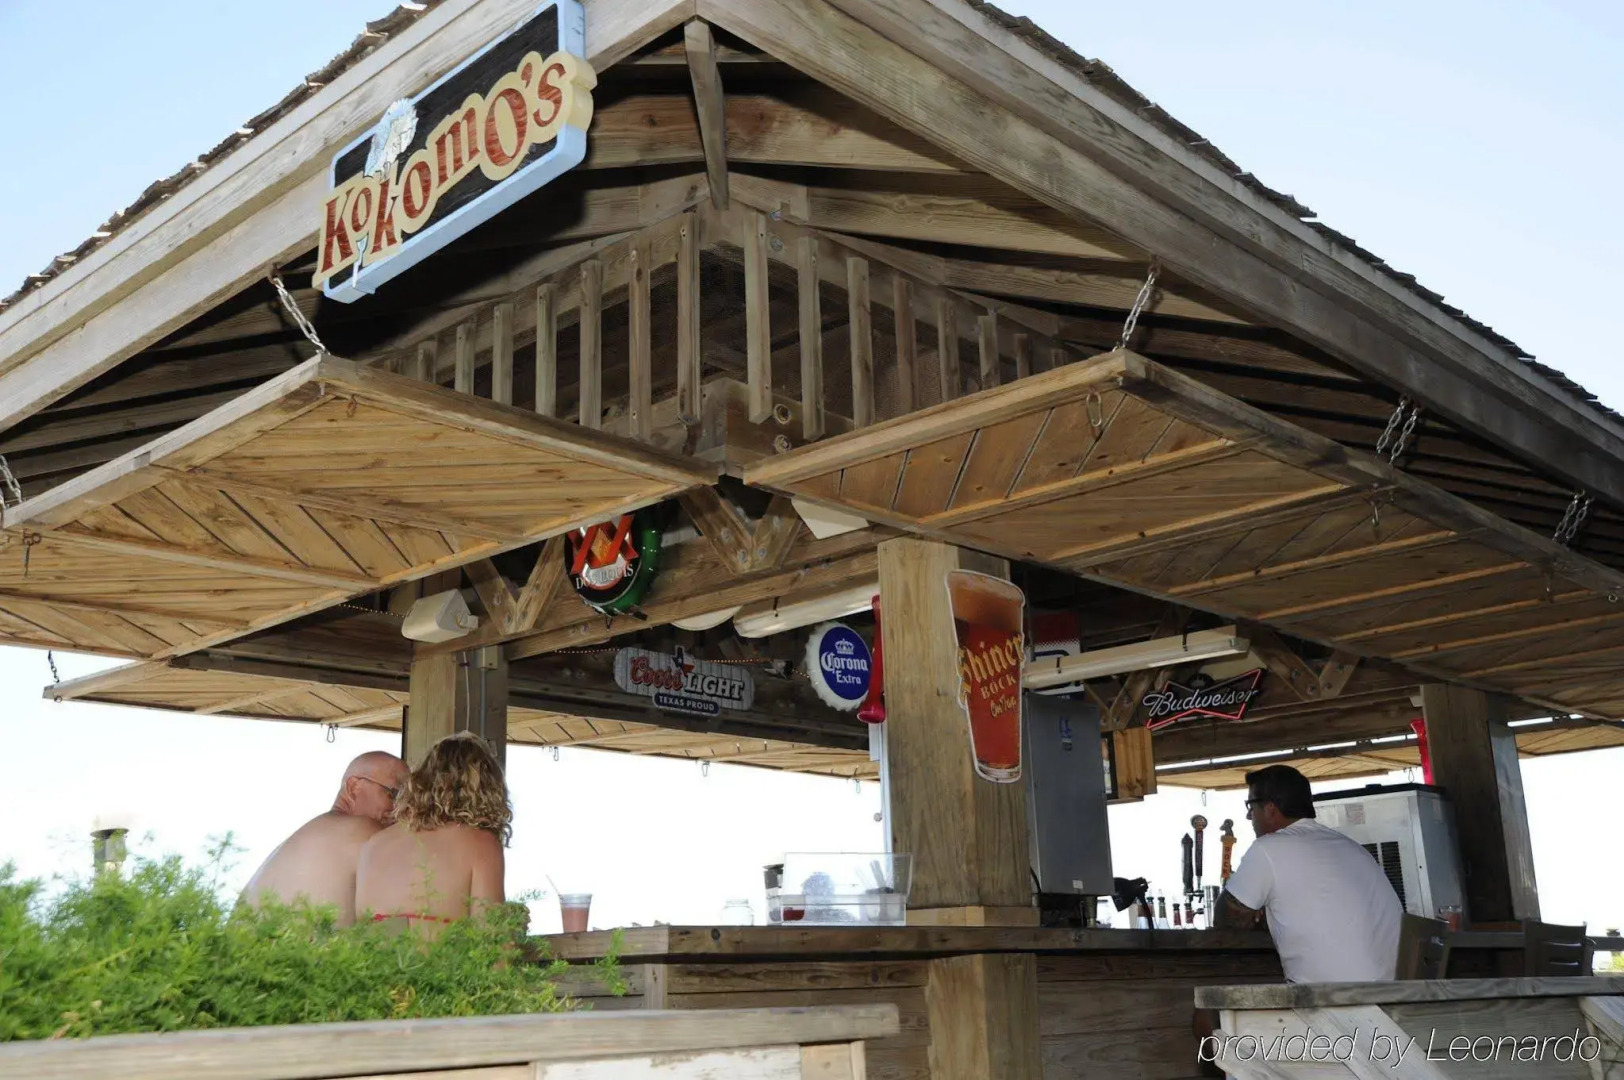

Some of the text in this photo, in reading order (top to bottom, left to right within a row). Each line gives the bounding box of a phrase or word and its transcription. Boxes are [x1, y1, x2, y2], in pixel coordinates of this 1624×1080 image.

[820, 651, 869, 674] Corona
[956, 633, 1023, 705] Shiner
[629, 655, 744, 701] Coors LIGHT
[835, 670, 862, 685] Extra
[980, 674, 1017, 700] BOCK
[658, 695, 715, 712] TEXAS PROUD
[1142, 688, 1259, 716] Budweiser
